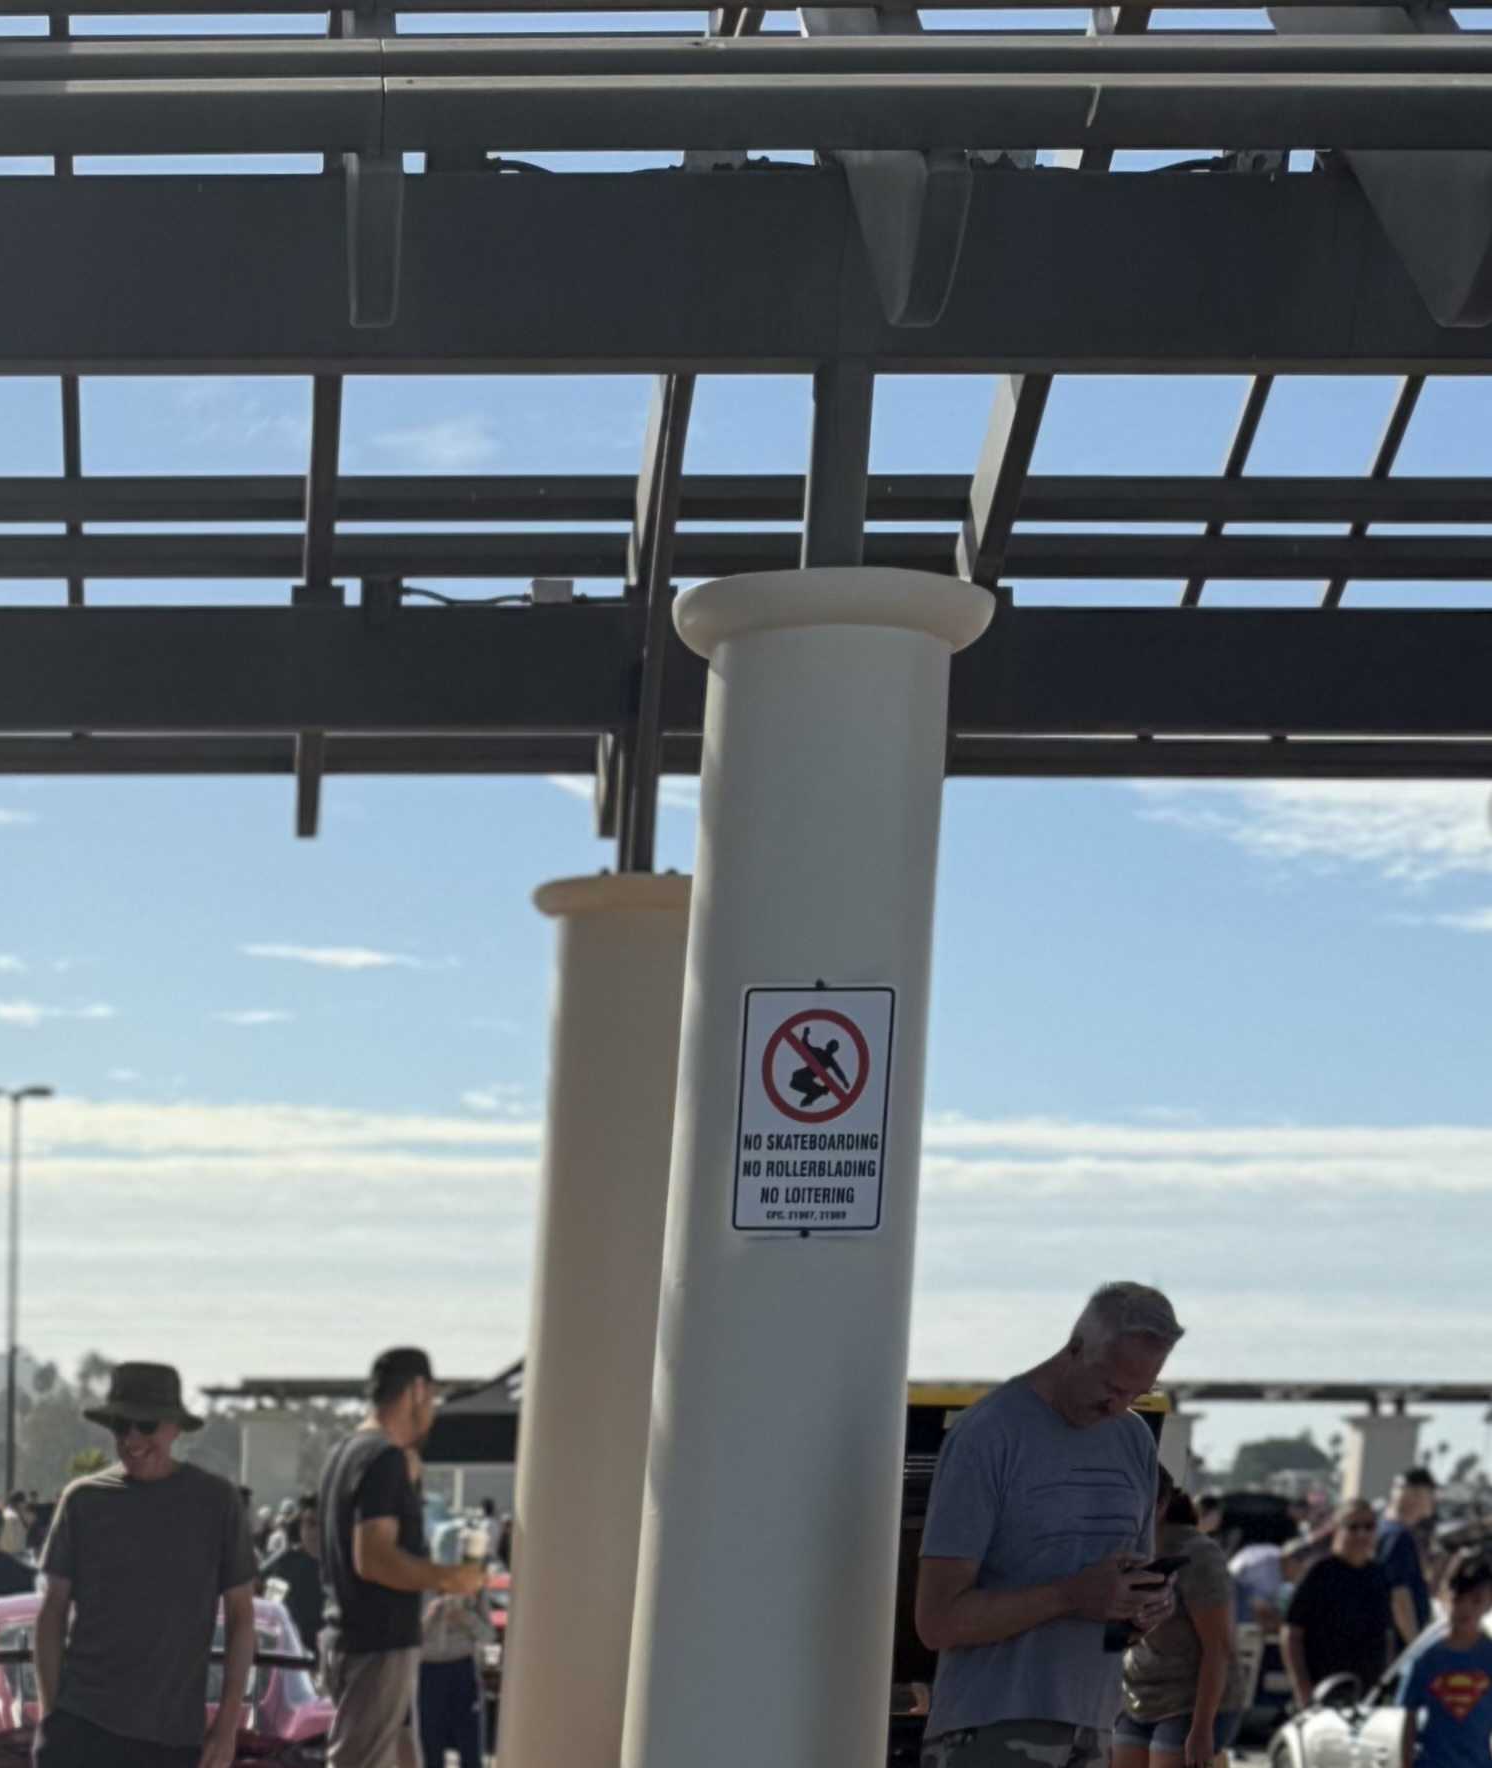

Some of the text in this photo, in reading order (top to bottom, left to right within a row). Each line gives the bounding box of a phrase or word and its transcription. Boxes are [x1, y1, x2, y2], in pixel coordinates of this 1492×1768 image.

[743, 1133, 879, 1151] NO SKATEBOARDING
[742, 1160, 877, 1177] NO ROLLERBLADING
[760, 1187, 855, 1204] NO LOITERING
